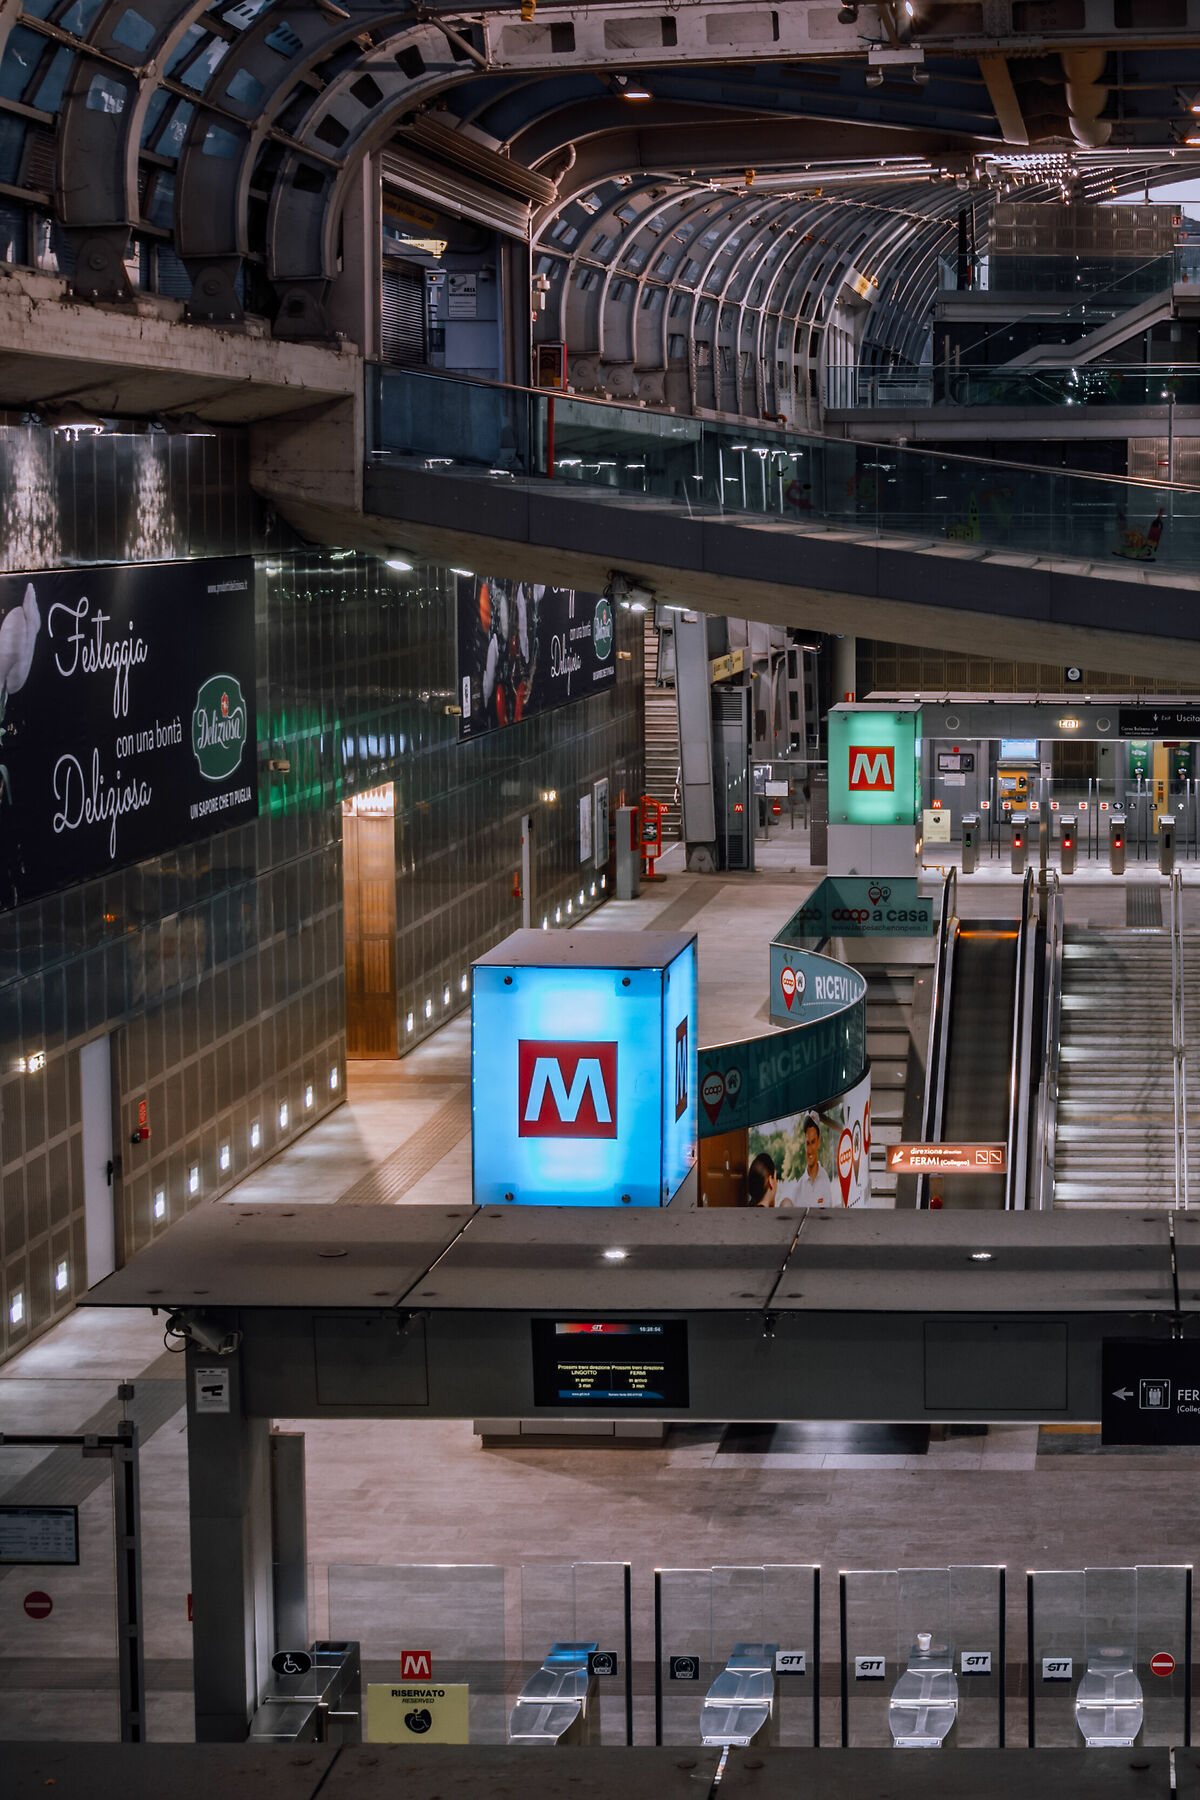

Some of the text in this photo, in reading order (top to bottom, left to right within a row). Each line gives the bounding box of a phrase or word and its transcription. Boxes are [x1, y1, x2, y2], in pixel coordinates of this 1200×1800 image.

[48, 596, 148, 719] Festeggia
[116, 716, 182, 760] con una bontà
[198, 706, 244, 750] Deliziosa
[851, 753, 892, 784] M
[53, 748, 152, 858] Deliziosa
[190, 786, 252, 820] UN SAPORE CHE TI PUGLIA
[832, 908, 870, 924] coop
[872, 911, 882, 922] a
[887, 910, 928, 922] casa
[816, 976, 848, 1002] RICEVI
[676, 1034, 688, 1106] M
[759, 1035, 817, 1090] RICEVI
[524, 1058, 612, 1122] M
[704, 1084, 723, 1096] coop
[910, 1147, 942, 1155] direzione
[910, 1157, 940, 1166] FERMI
[403, 1656, 430, 1674] M
[780, 1656, 803, 1666] GTT
[858, 1660, 884, 1671] GTT
[964, 1655, 989, 1666] GTT
[1046, 1662, 1070, 1673] GTT
